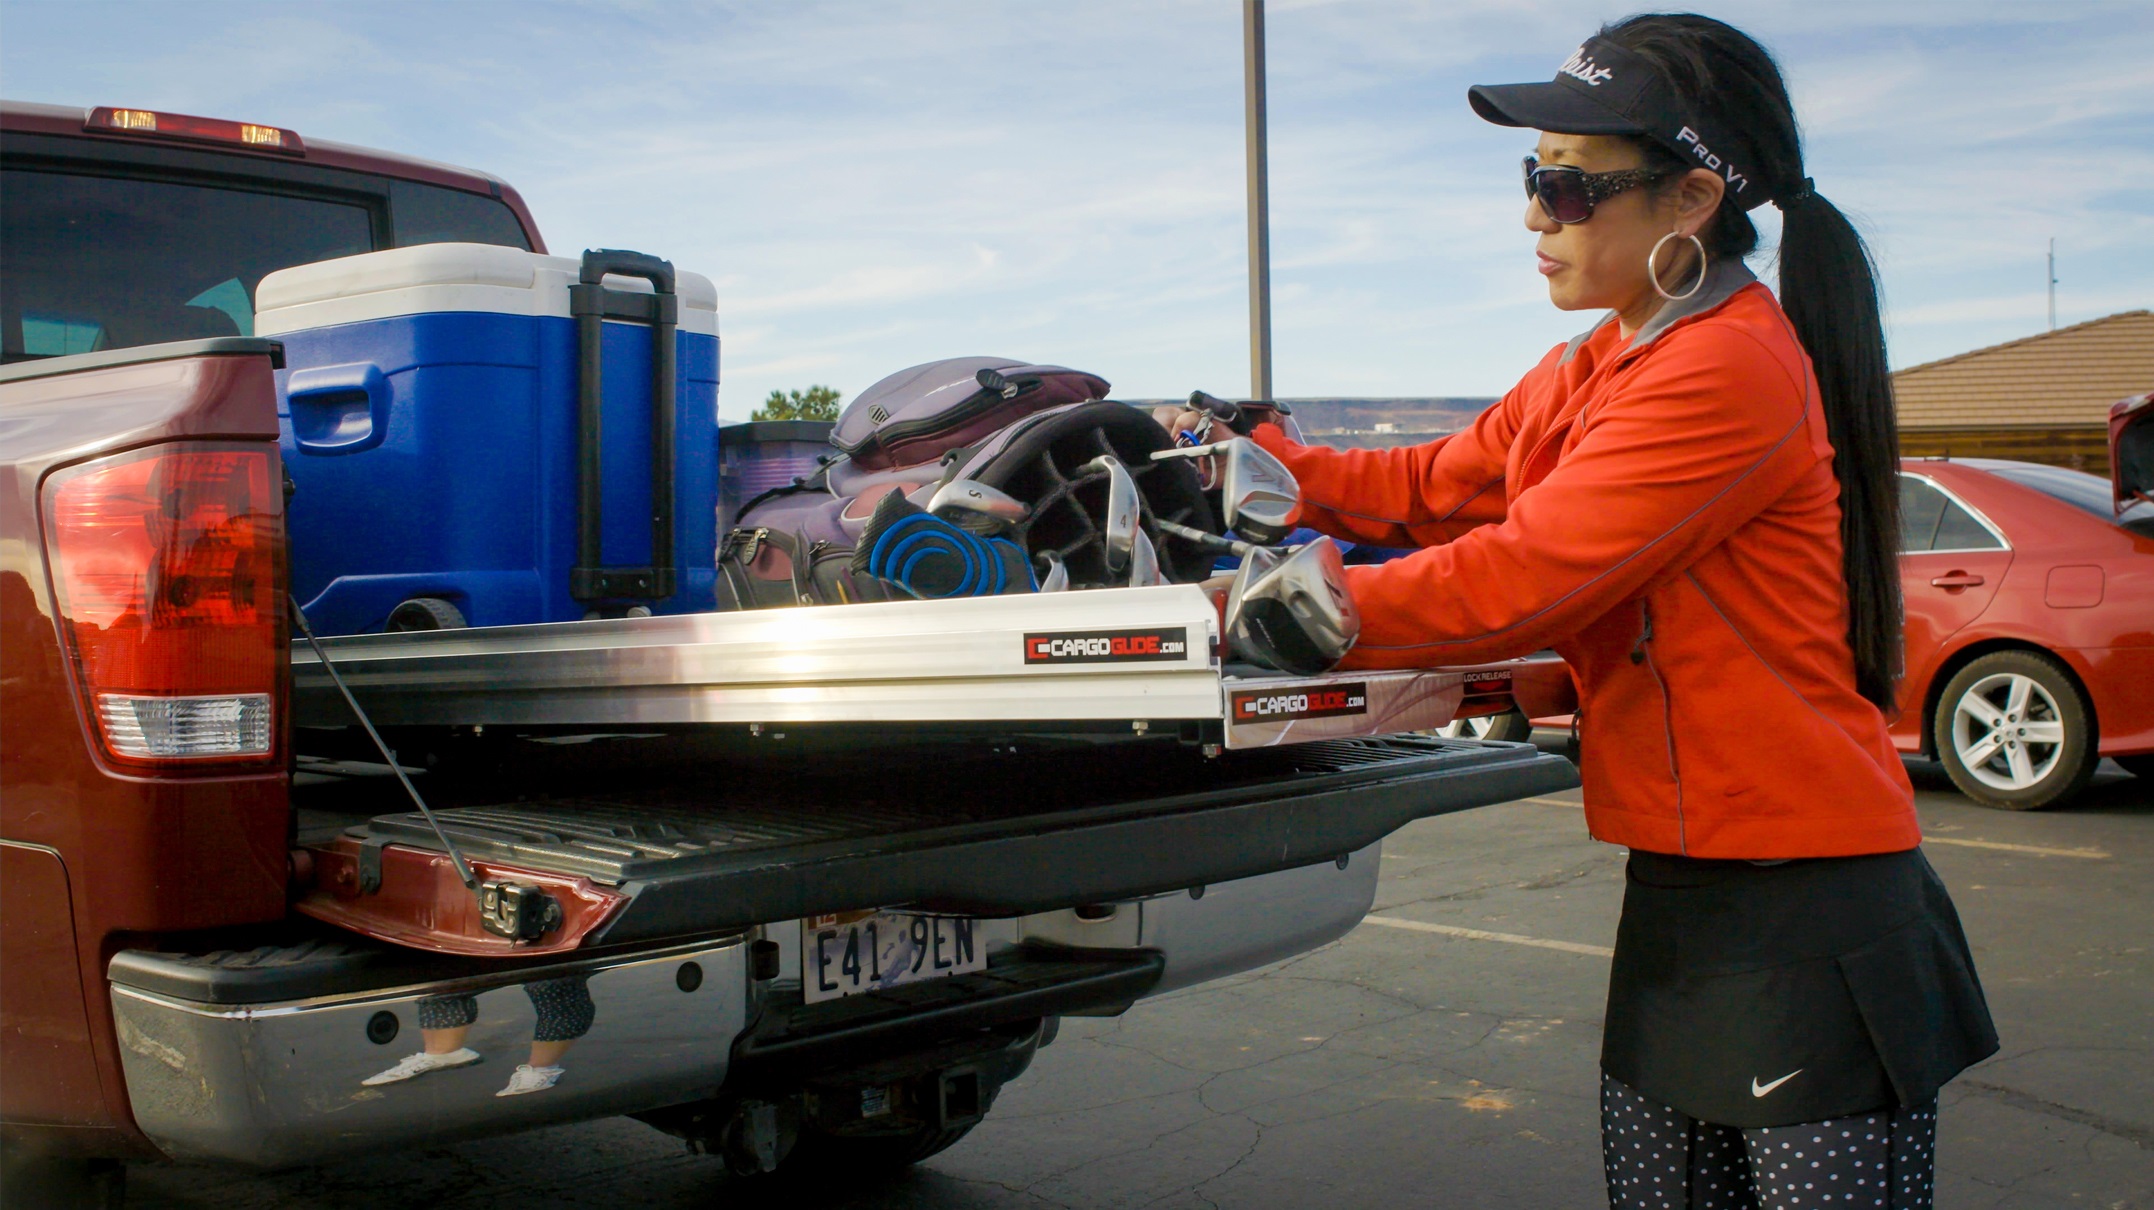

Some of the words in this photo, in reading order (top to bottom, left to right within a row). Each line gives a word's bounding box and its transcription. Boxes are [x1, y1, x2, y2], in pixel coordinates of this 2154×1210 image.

[1558, 46, 1613, 86] leist
[1726, 164, 1748, 193] V1
[1119, 514, 1127, 528] 4
[1463, 673, 1480, 682] LOCK
[1481, 671, 1511, 681] RELEASE
